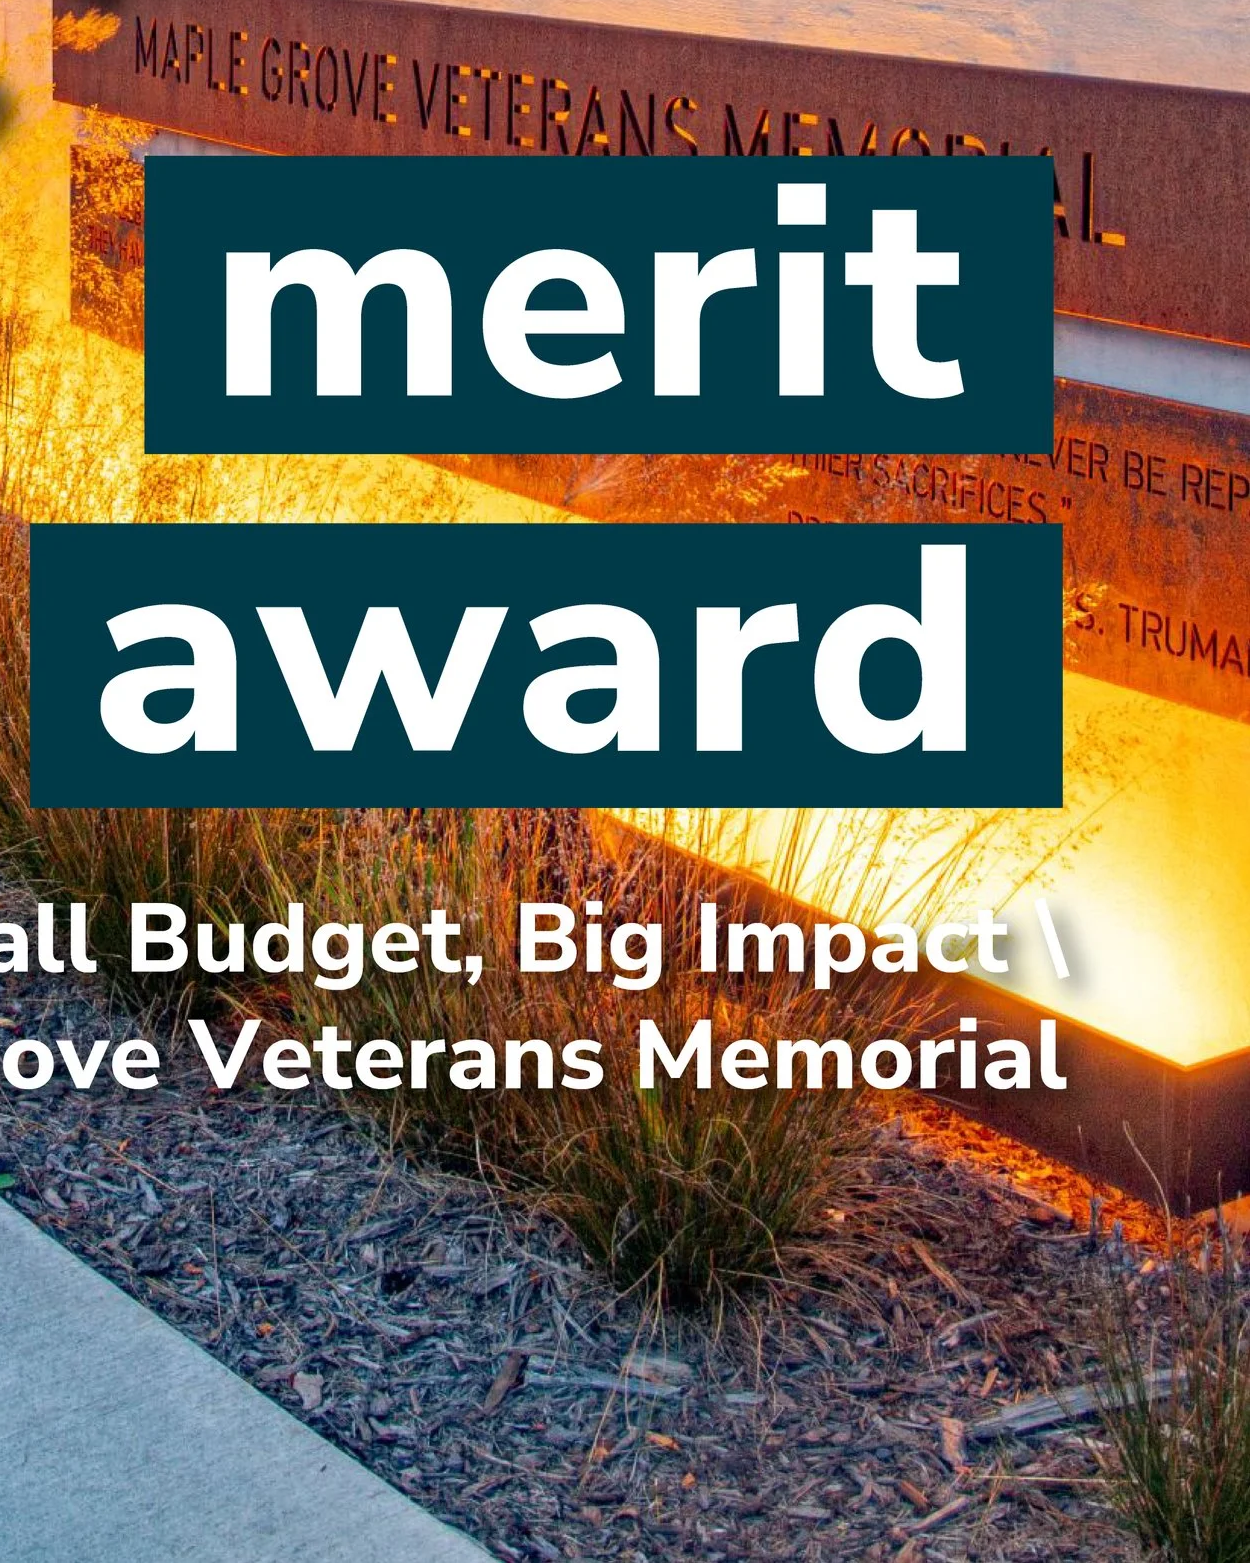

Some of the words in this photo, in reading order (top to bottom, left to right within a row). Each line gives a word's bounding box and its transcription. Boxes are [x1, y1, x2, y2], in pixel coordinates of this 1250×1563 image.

[134, 15, 249, 95] MAPLE
[261, 36, 398, 123] GROVE
[412, 59, 698, 156] VETERANS
[1124, 450, 1167, 496] BE
[1118, 602, 1250, 678] TRUMA
